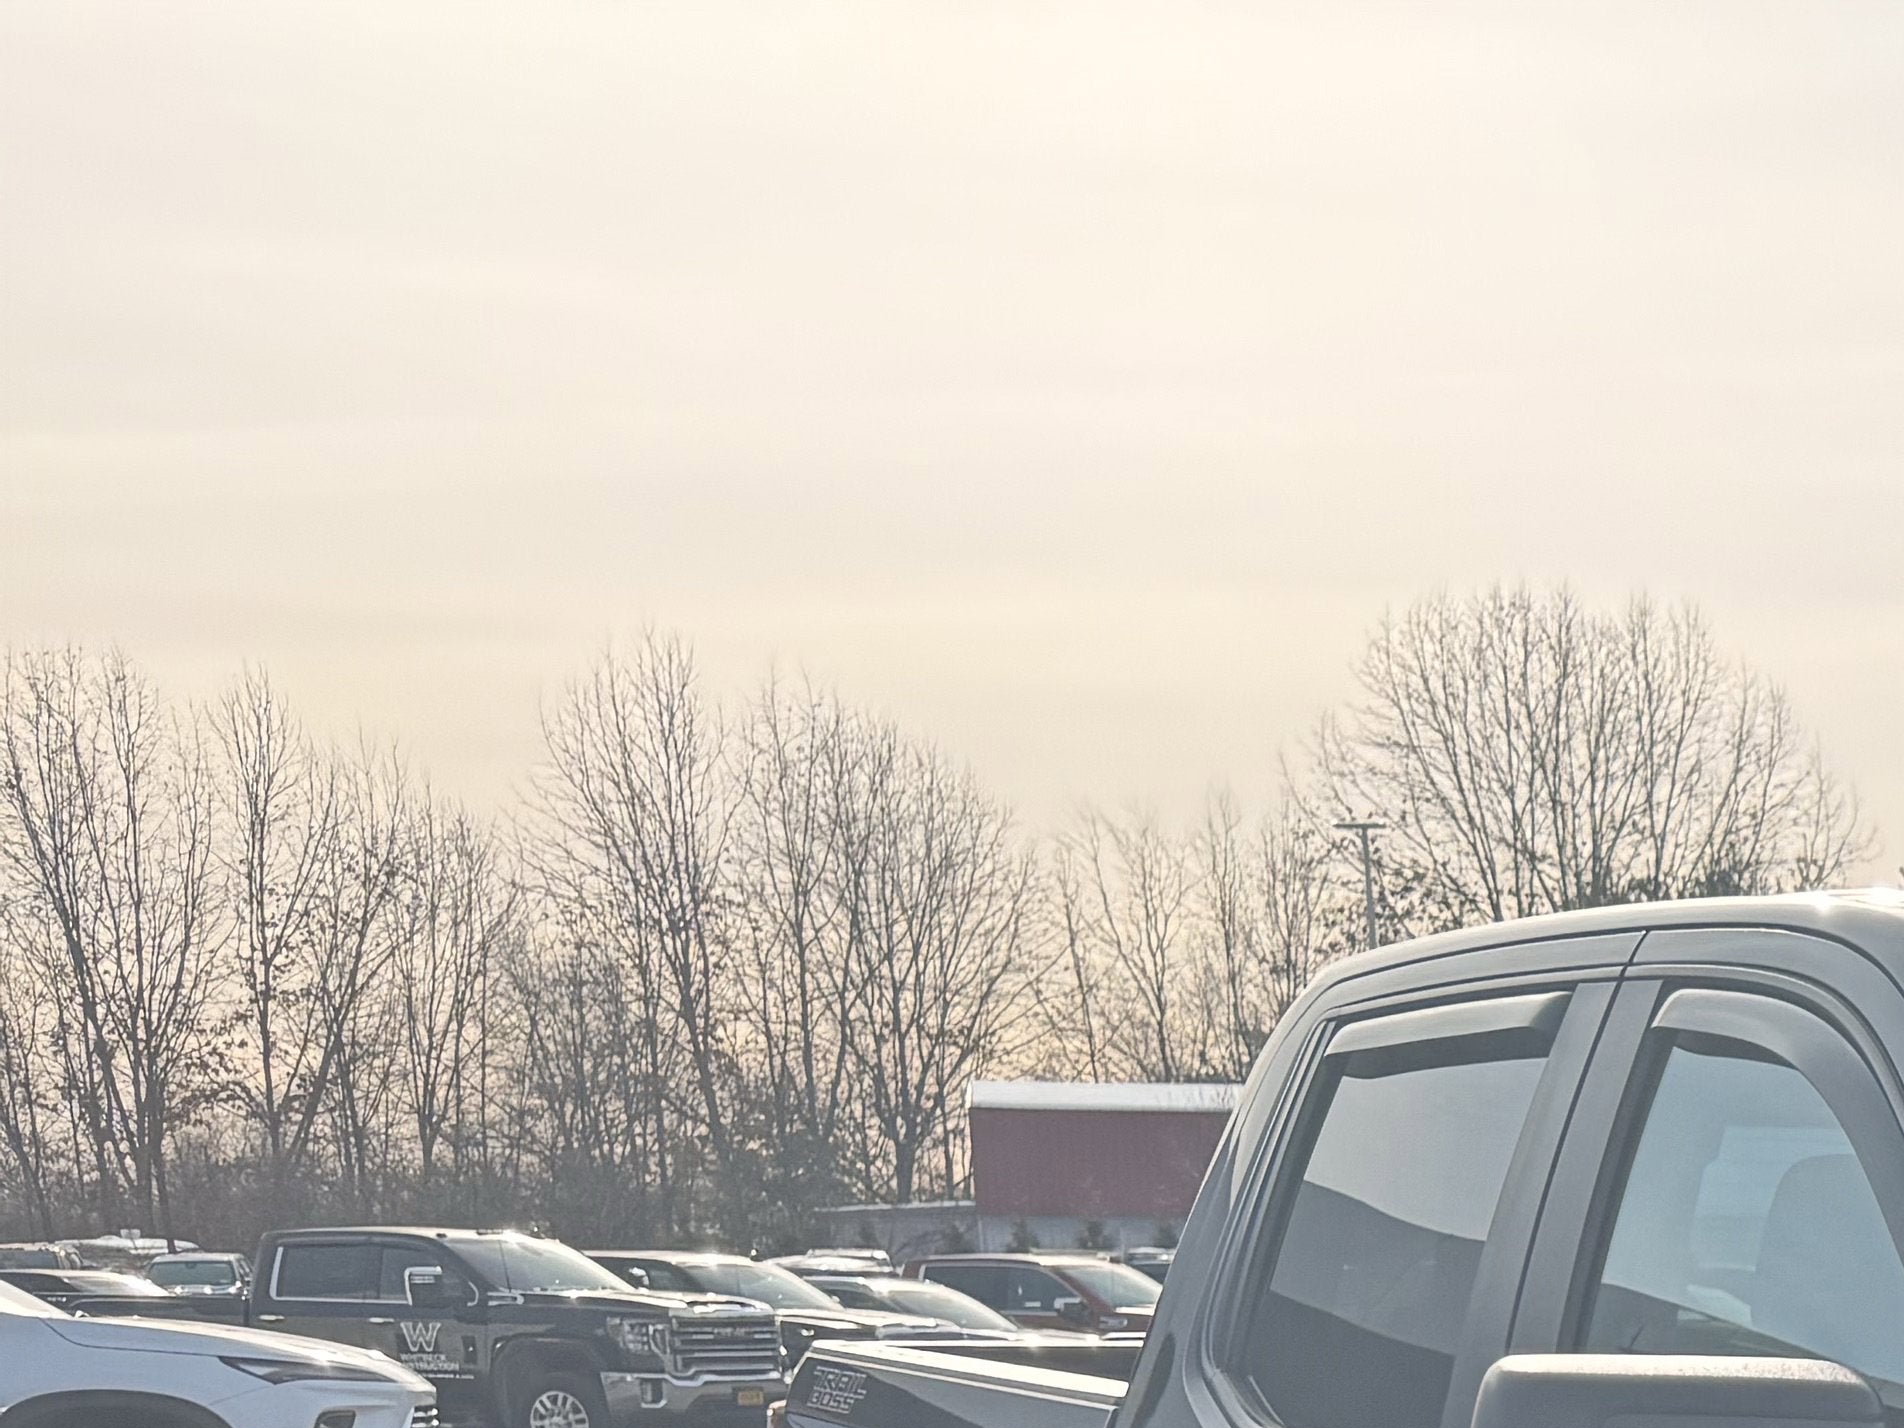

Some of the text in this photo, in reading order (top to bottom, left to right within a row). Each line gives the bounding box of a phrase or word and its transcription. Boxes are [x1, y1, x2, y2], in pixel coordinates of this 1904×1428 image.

[400, 1321, 441, 1352] W
[813, 1366, 867, 1397] TRAIL
[807, 1387, 857, 1414] BOSS
